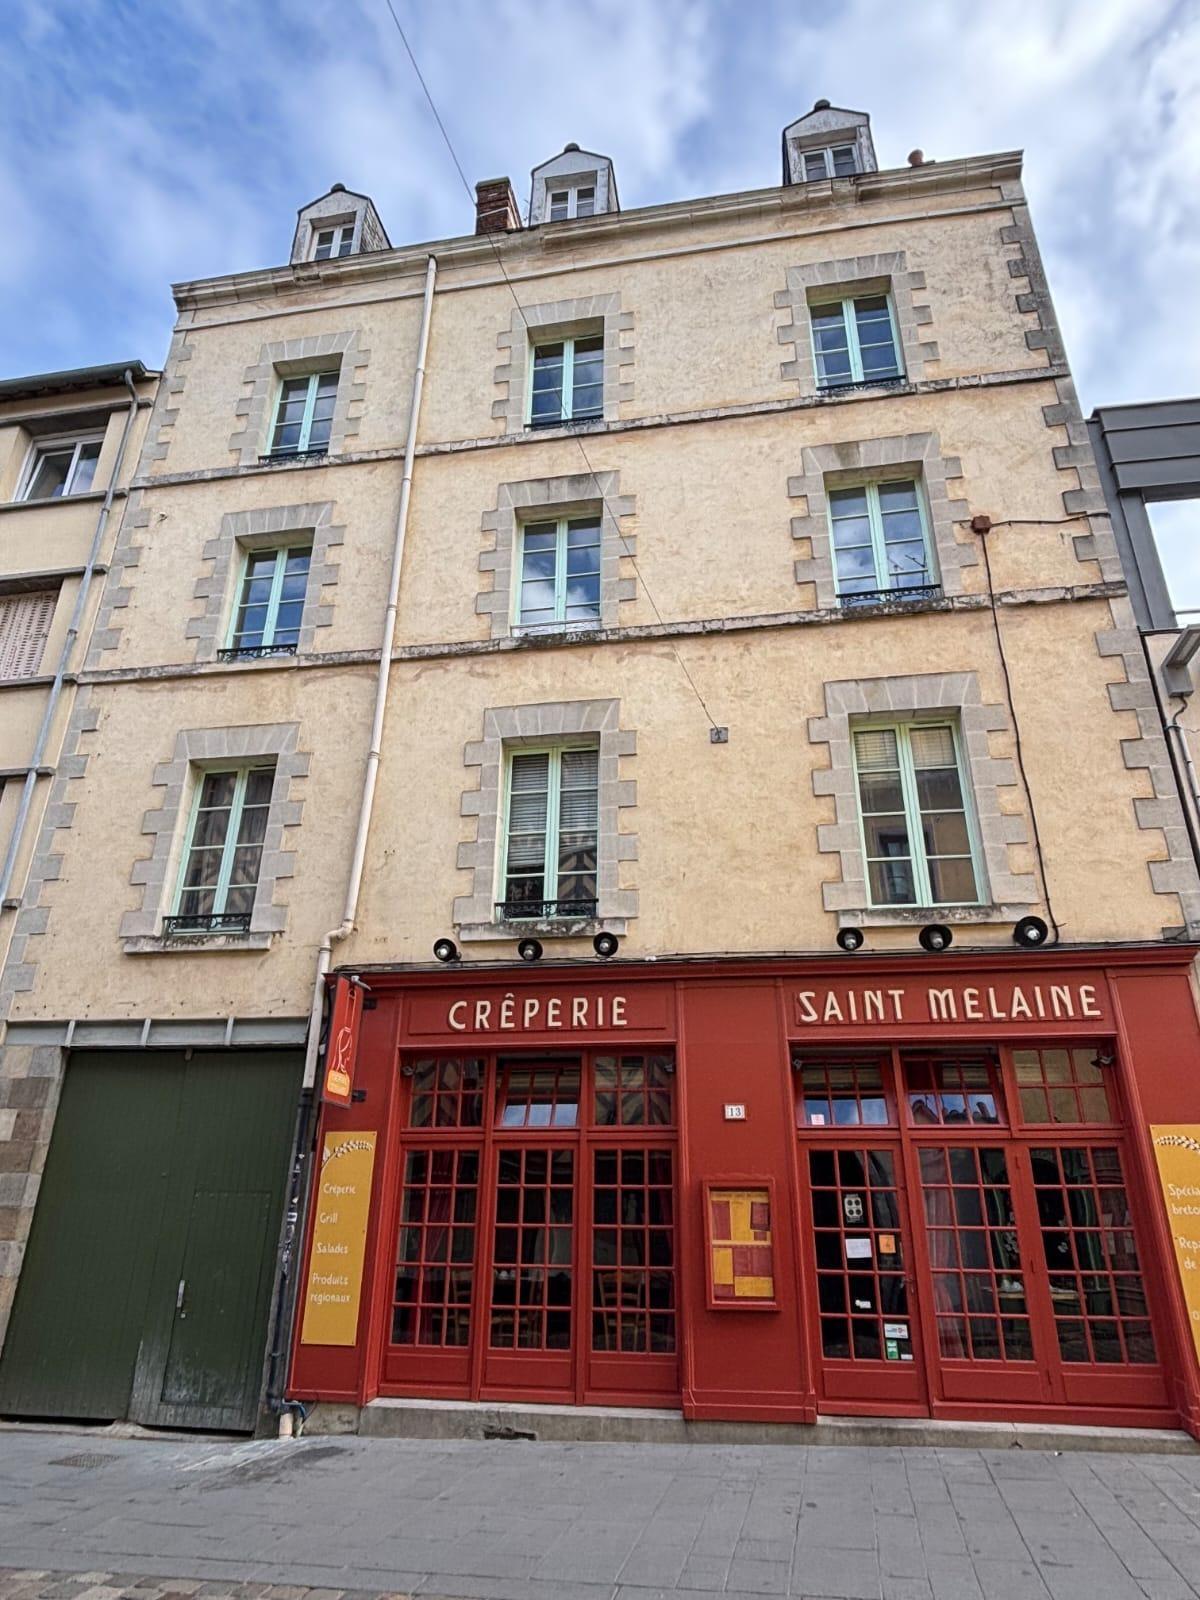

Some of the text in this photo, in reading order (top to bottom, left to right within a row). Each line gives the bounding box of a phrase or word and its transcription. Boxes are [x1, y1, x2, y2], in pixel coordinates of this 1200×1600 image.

[799, 985, 1102, 1023] SAINT MELAINE
[448, 993, 628, 1030] CRÊPERIE
[730, 1107, 742, 1117] 13
[319, 1212, 338, 1224] Grill
[316, 1242, 348, 1254] Salades
[1184, 1256, 1197, 1270] de
[312, 1272, 348, 1285] Produits
